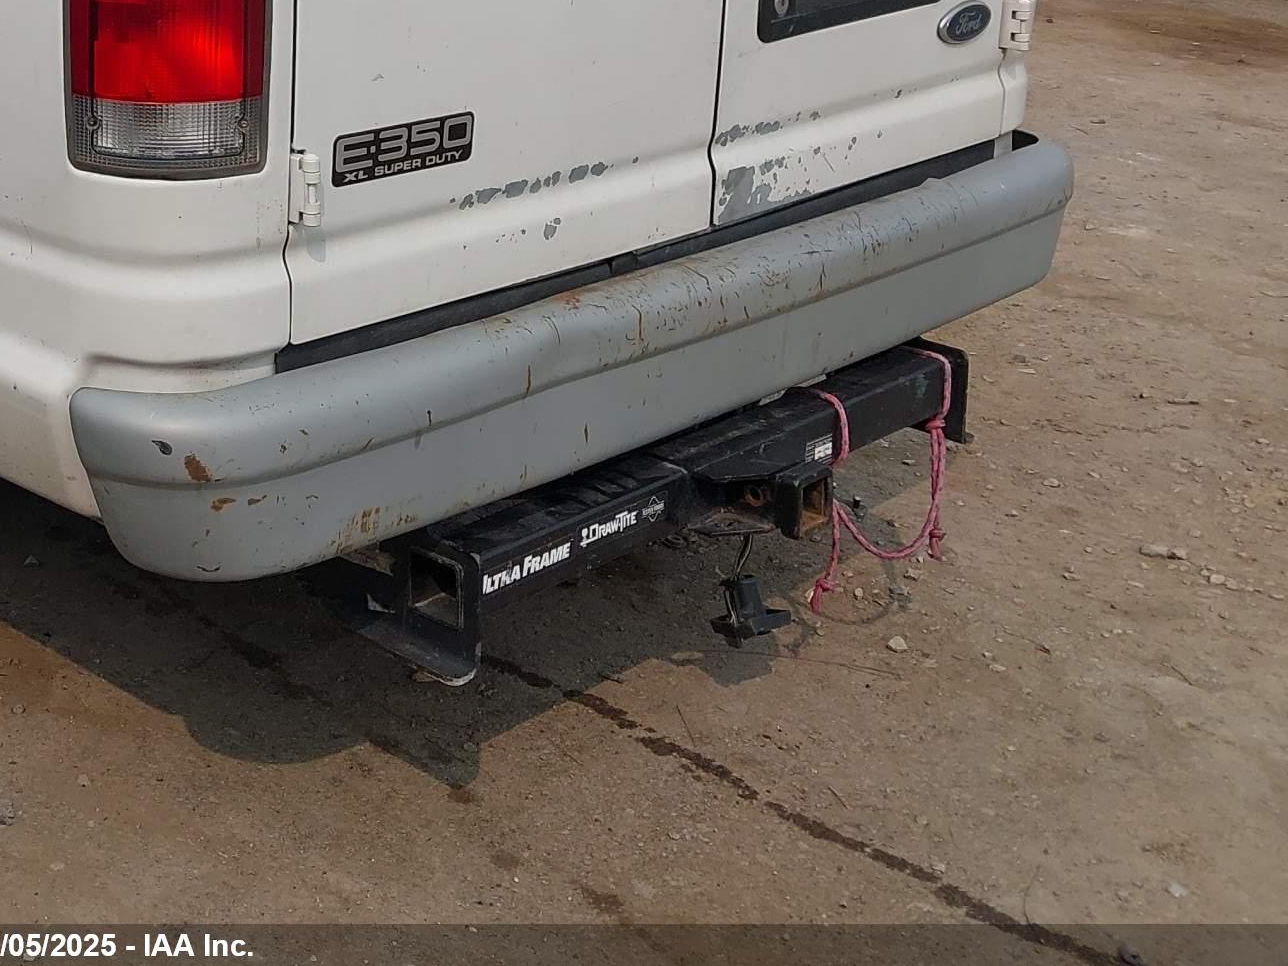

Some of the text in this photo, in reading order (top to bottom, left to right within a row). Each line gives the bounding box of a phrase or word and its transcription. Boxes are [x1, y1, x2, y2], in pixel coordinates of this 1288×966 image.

[956, 11, 983, 35] Ford
[343, 150, 462, 183] XL SUPER DUTY
[522, 542, 571, 577] FRAME
